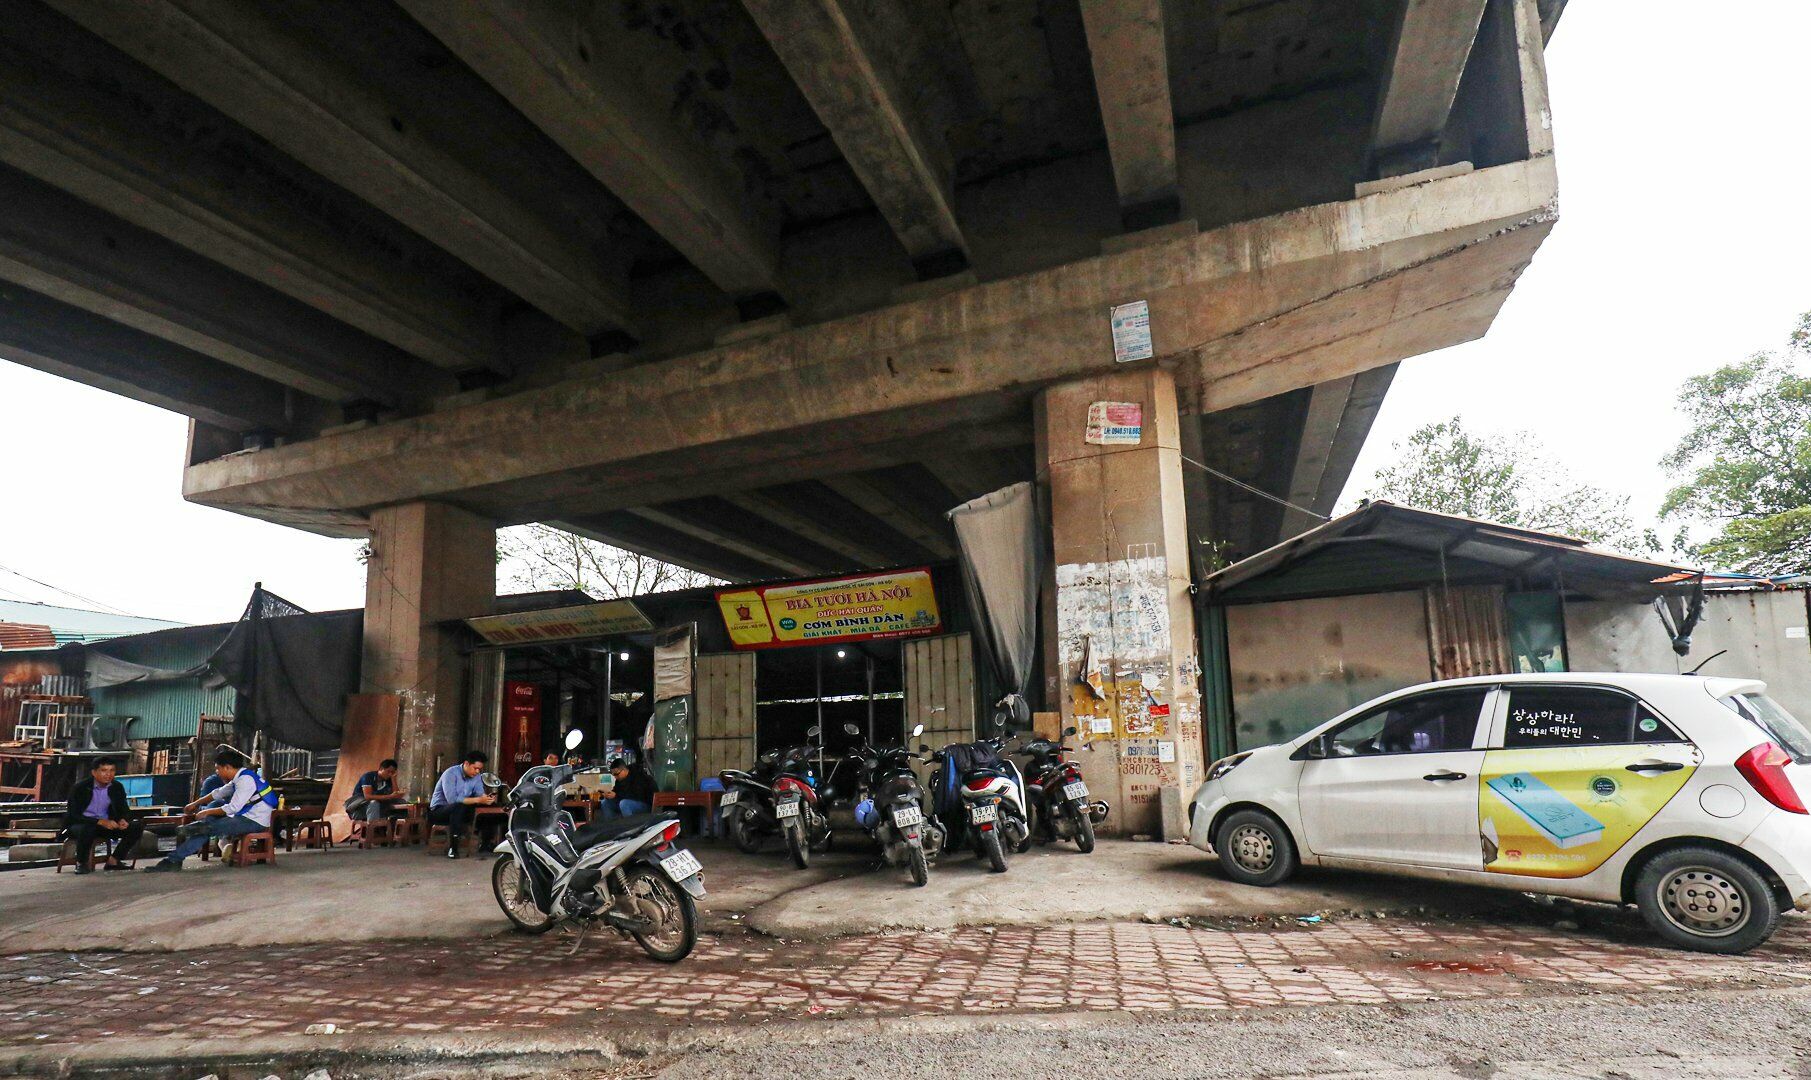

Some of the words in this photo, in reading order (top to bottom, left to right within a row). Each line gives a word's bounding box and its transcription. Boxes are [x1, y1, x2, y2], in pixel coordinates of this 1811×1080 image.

[786, 598, 812, 610] BIA
[814, 592, 852, 608] TƯƠI
[856, 588, 879, 603] HÀ
[882, 585, 912, 601] NỘI
[804, 621, 832, 630] CƠM
[835, 617, 870, 626] BÌNH
[873, 614, 904, 623] DÂN
[1519, 728, 1547, 737] 우리들의
[666, 852, 689, 868] 28-H1
